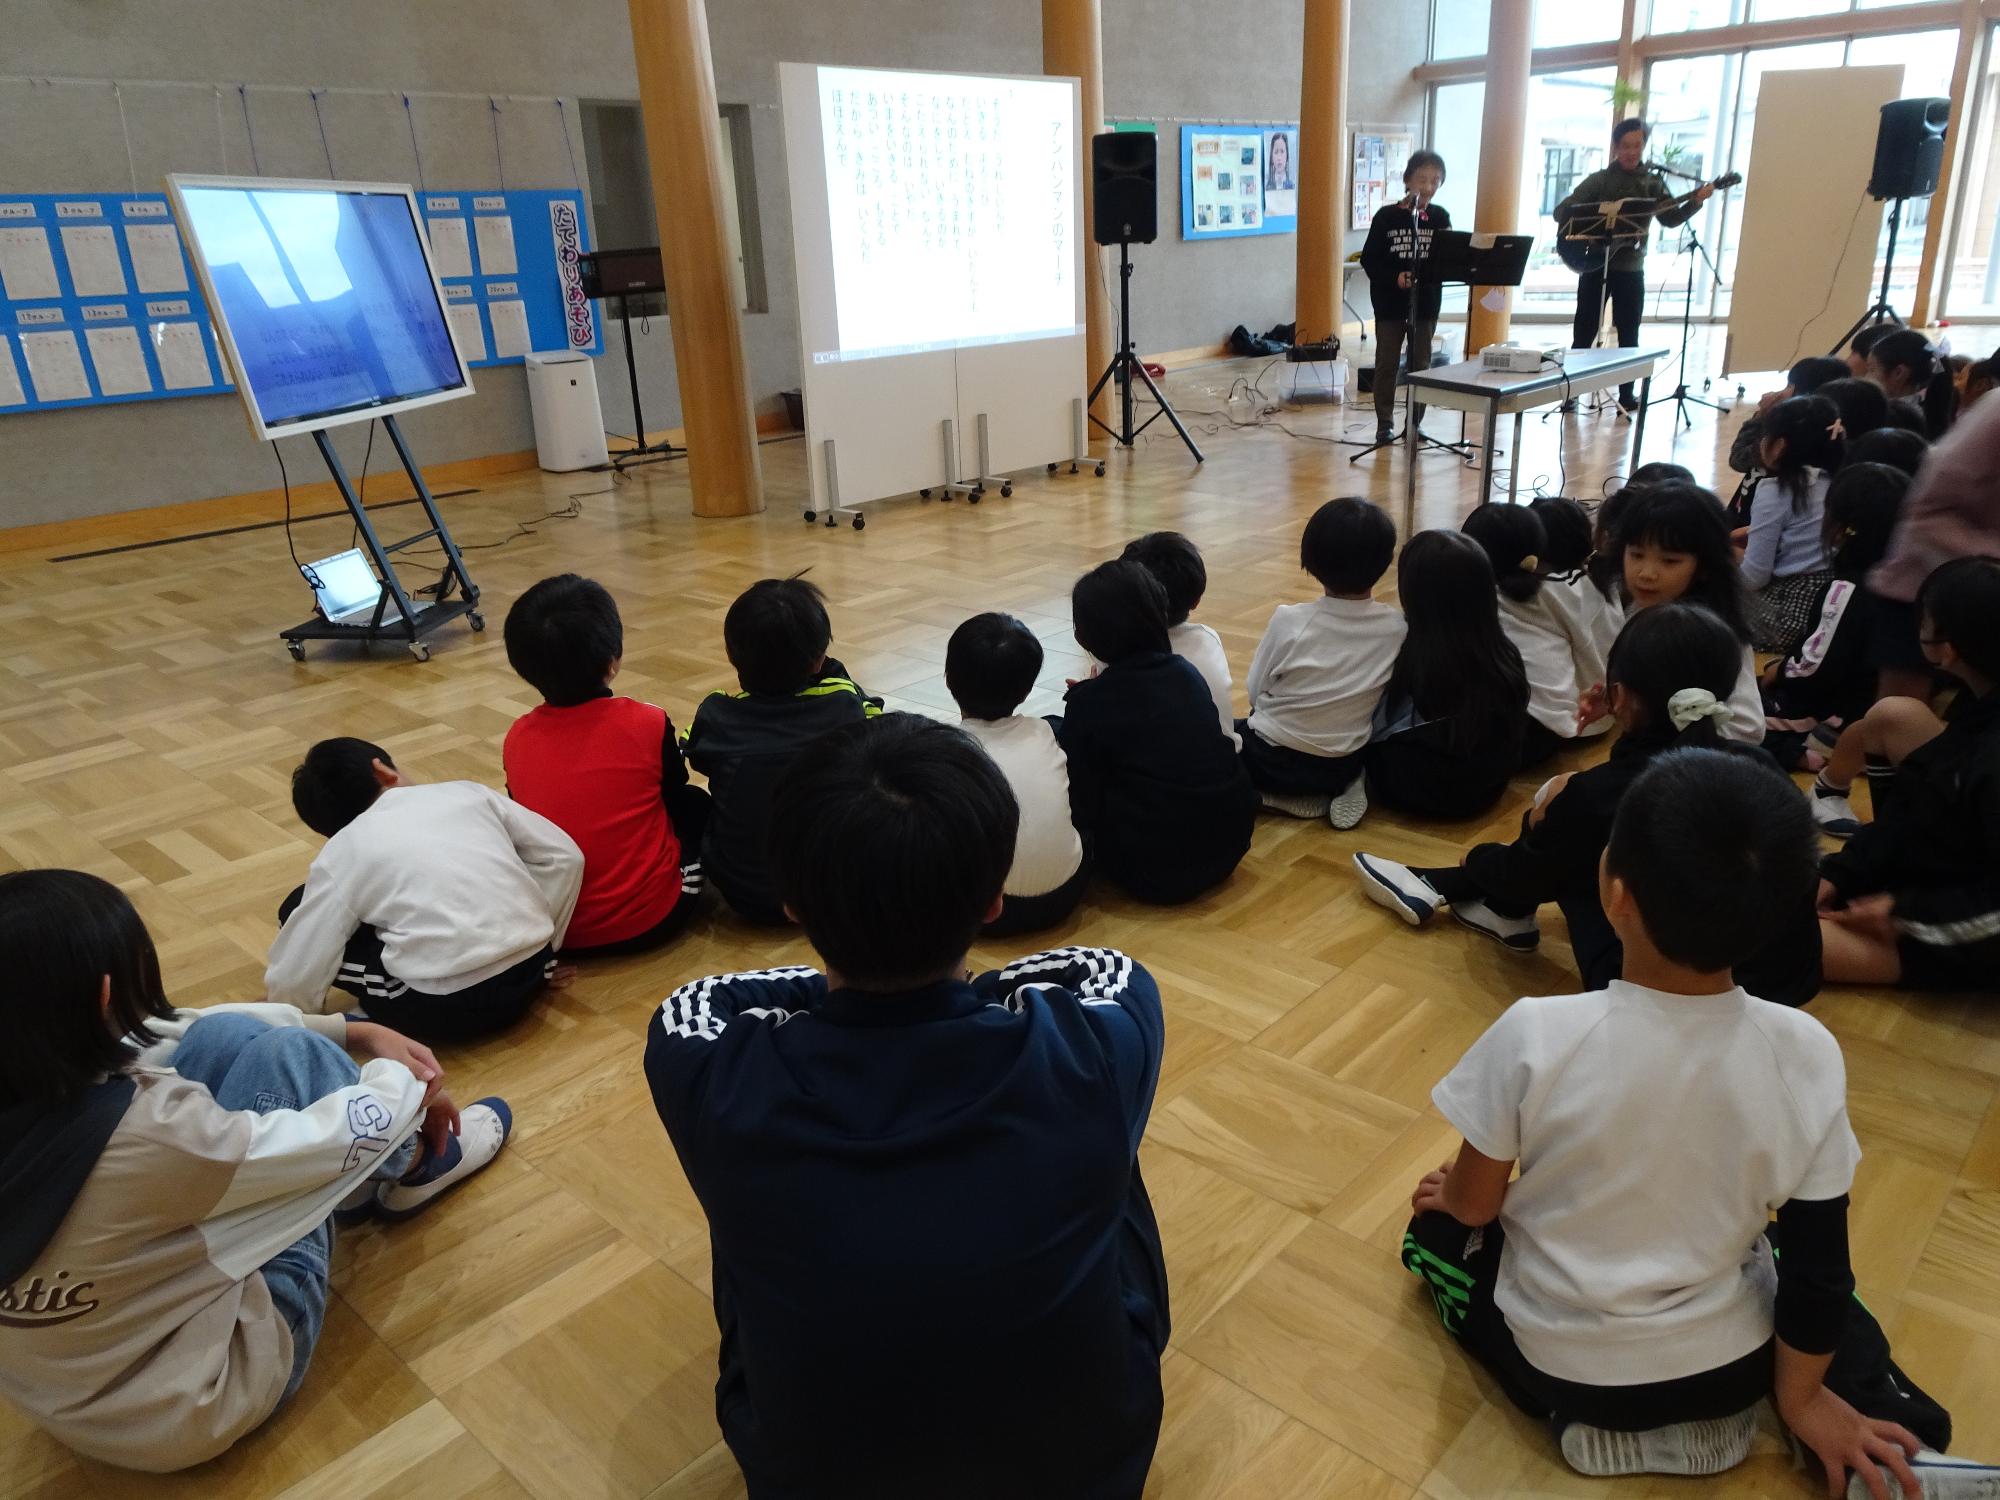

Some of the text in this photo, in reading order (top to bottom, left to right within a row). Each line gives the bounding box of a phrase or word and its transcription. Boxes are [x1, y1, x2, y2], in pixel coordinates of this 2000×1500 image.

[554, 203, 593, 346] たてわりあそび
